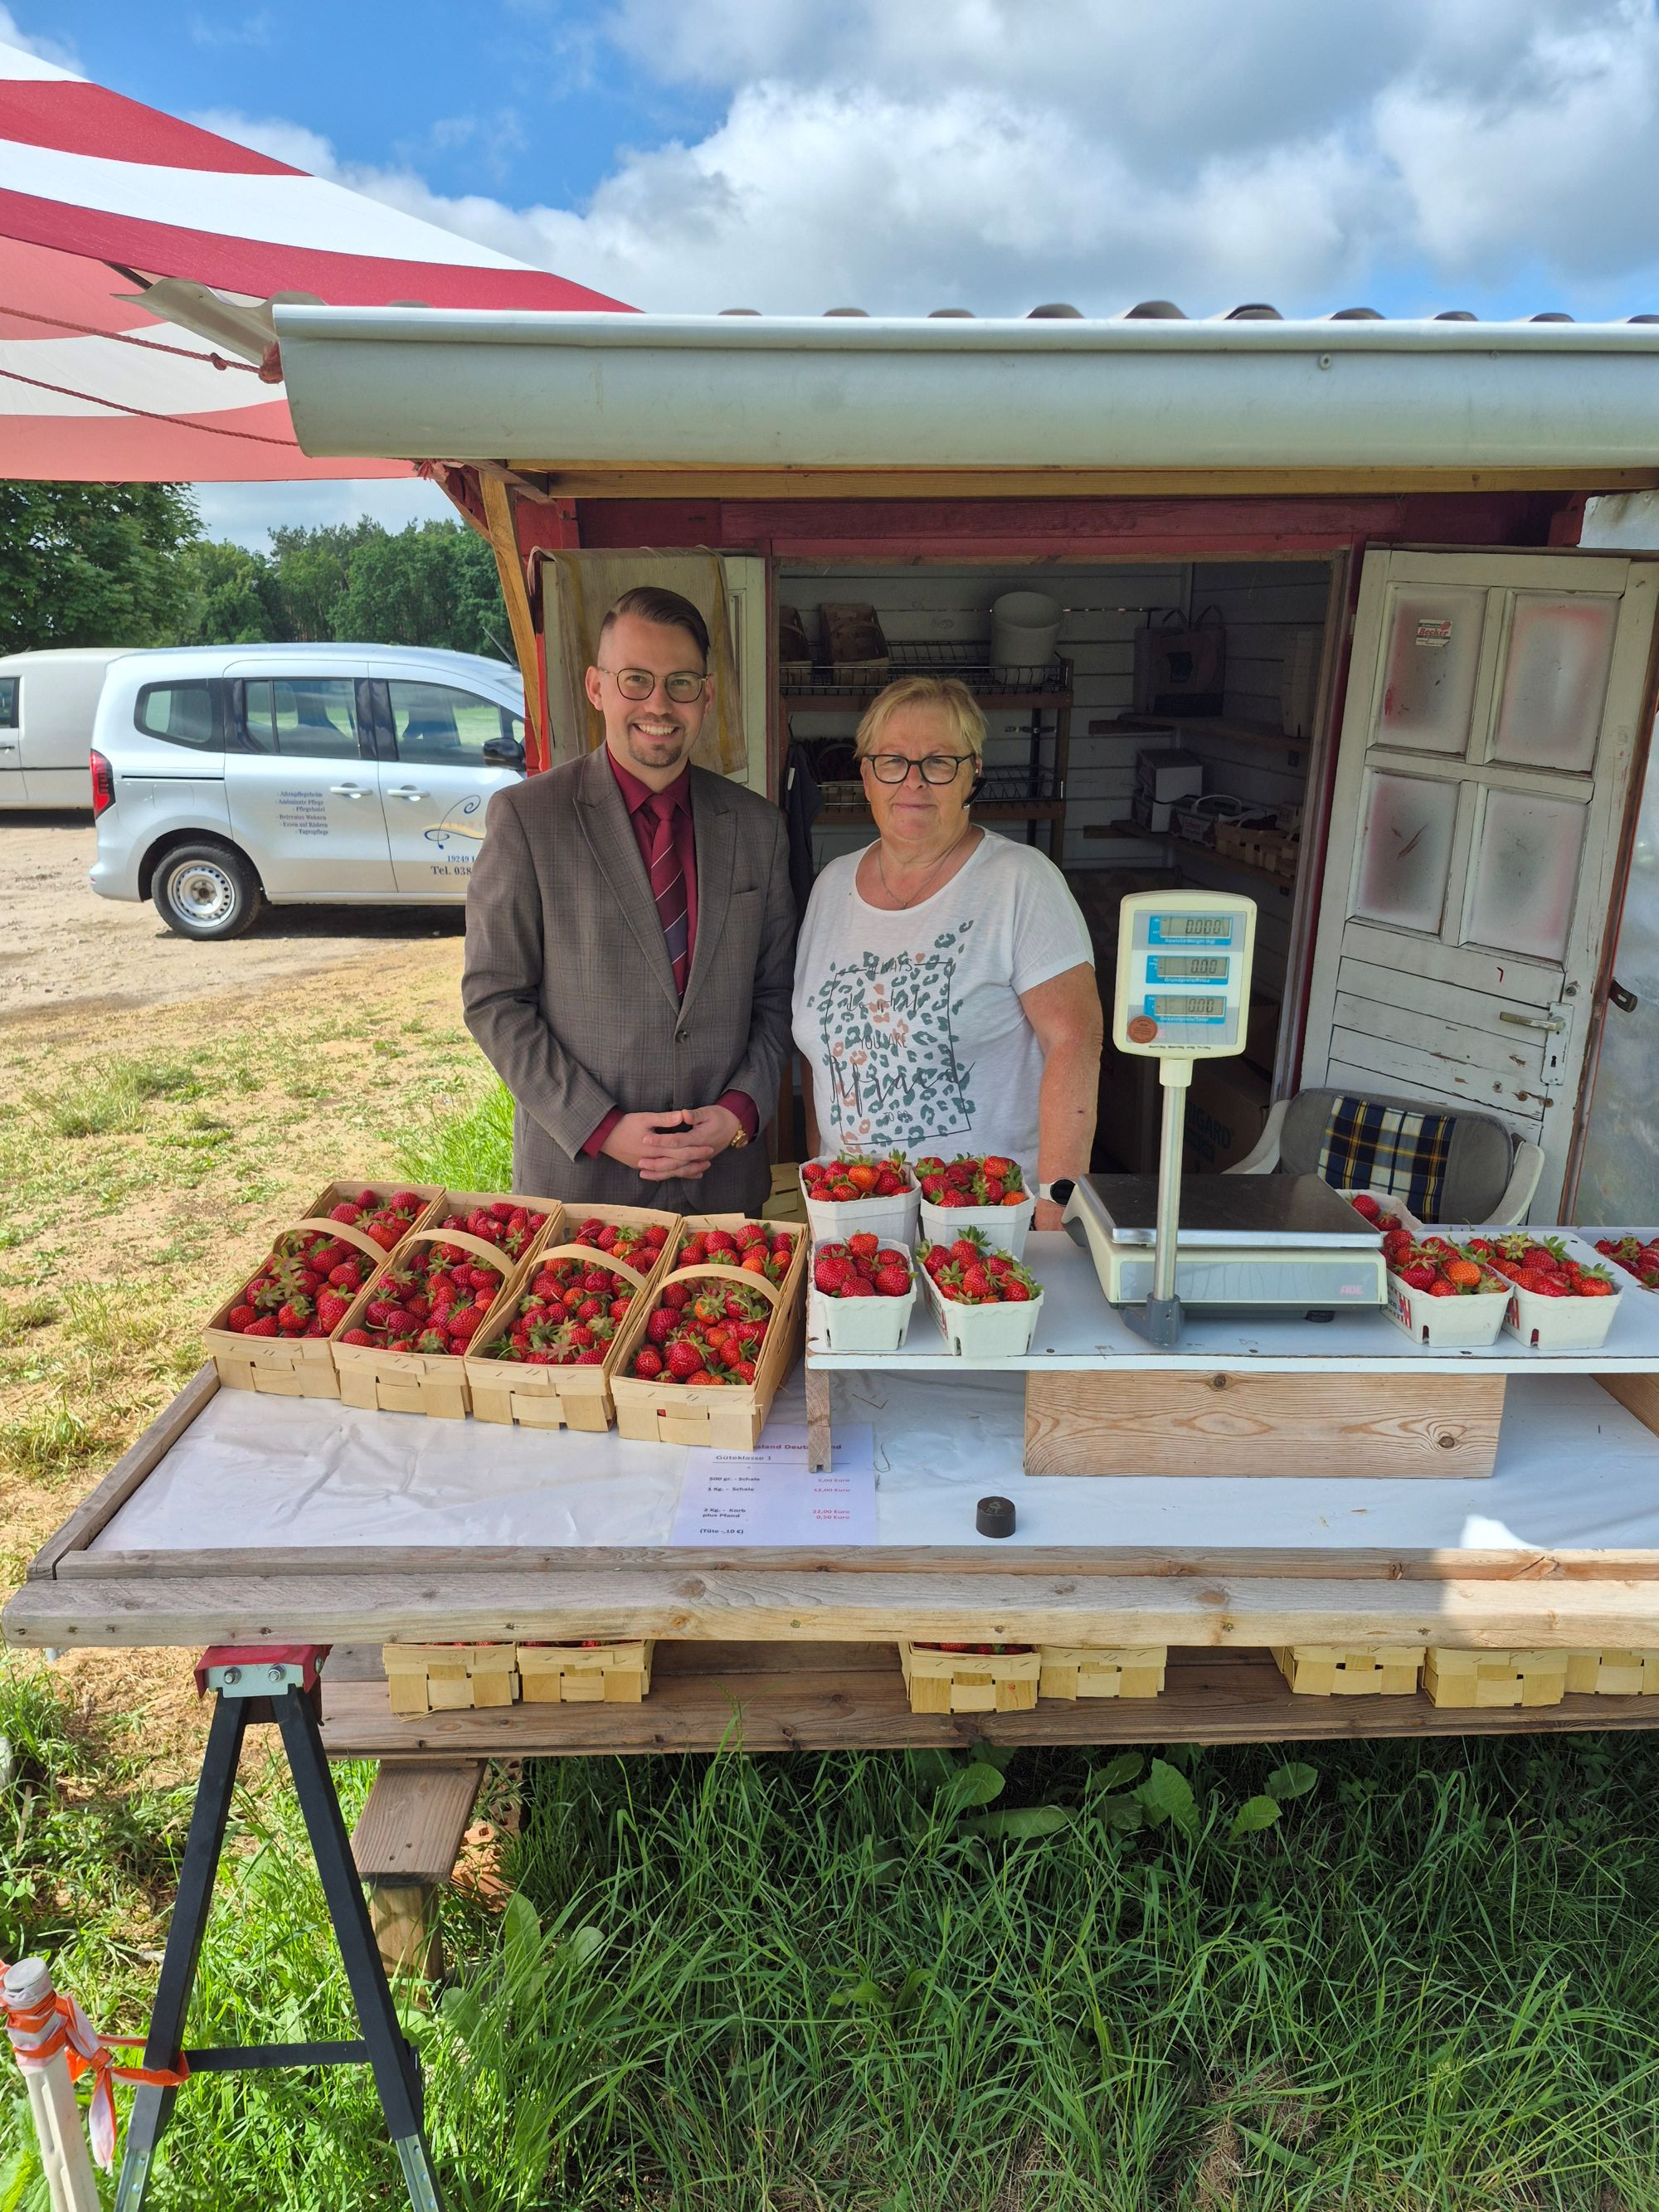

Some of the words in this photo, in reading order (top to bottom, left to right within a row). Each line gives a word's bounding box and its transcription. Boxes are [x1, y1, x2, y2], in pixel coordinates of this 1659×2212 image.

[1419, 628, 1448, 636] Becker
[431, 866, 451, 875] Tel.
[454, 866, 472, 875] 038
